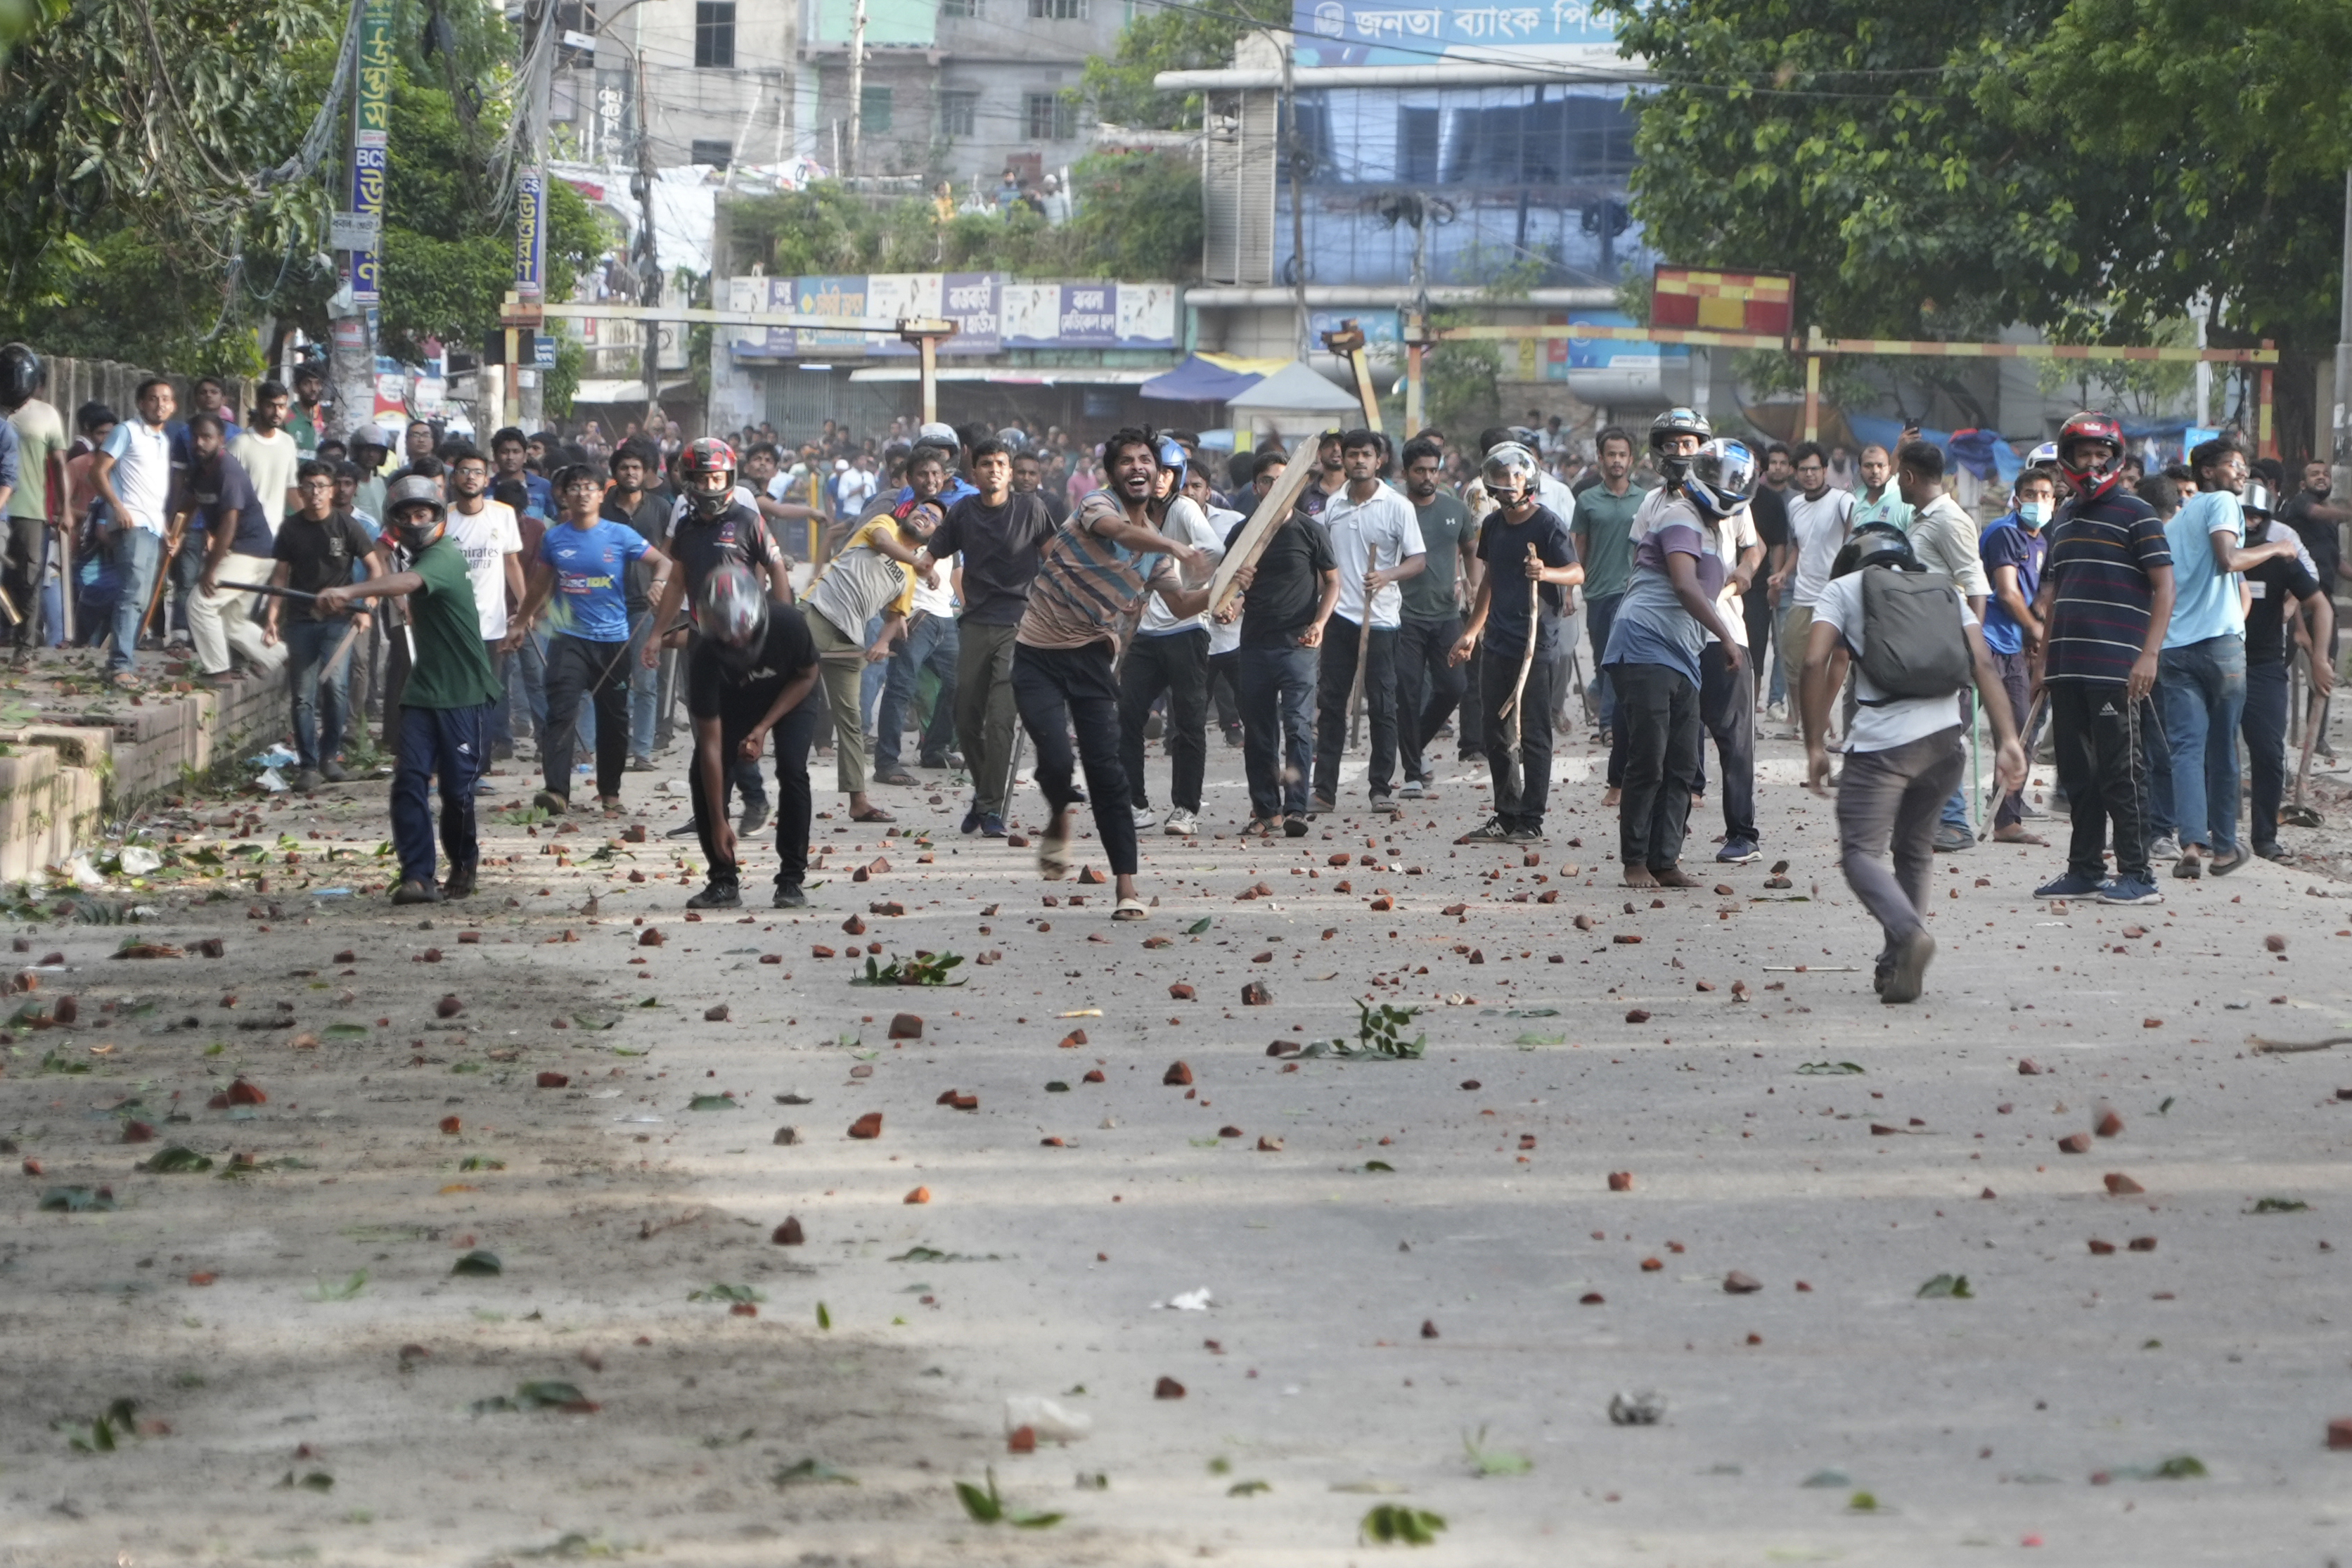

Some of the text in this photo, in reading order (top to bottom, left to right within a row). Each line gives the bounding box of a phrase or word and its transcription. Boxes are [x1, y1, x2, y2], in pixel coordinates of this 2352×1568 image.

[1353, 6, 1444, 39] জনতা
[1453, 5, 1542, 37] ব্যাংক
[518, 179, 540, 193] CS
[459, 546, 499, 558] mirates
